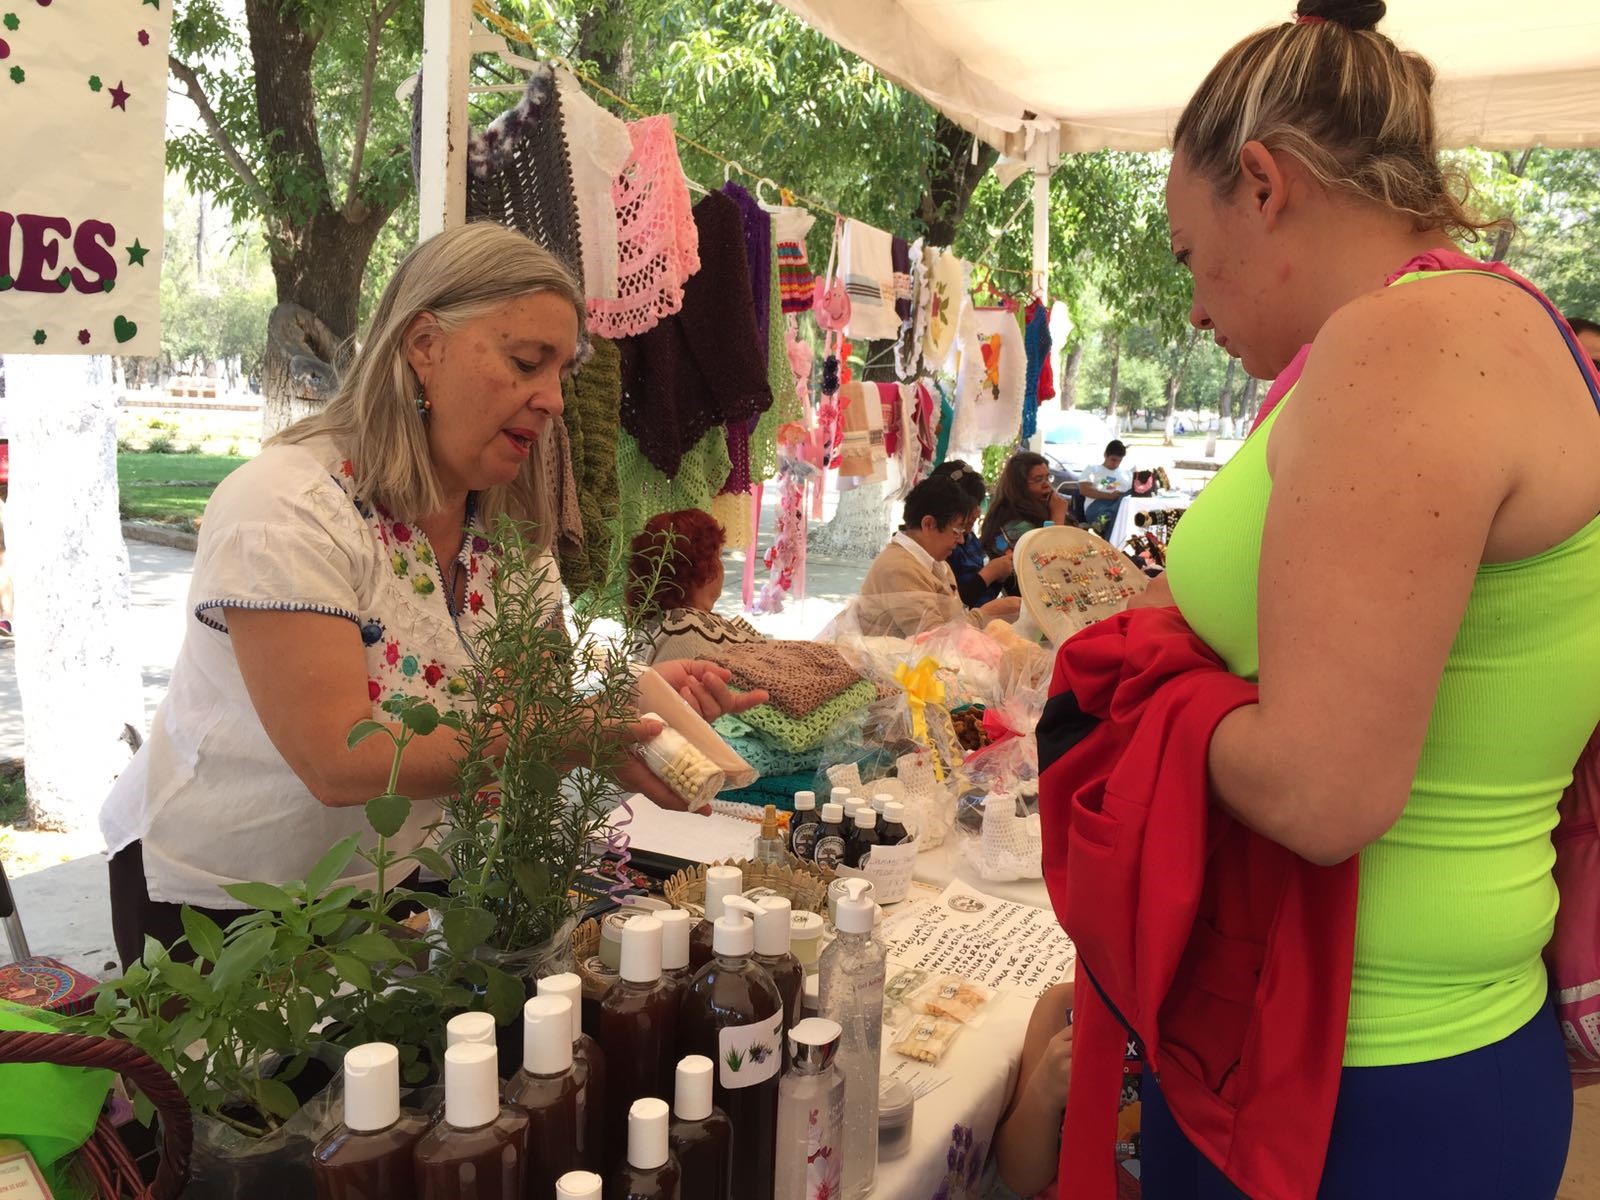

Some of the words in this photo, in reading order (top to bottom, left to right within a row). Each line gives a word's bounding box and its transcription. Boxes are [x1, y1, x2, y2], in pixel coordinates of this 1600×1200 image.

[973, 946, 1007, 982] DOLORES
[1007, 955, 1019, 967] DE
[1011, 953, 1038, 986] JARABE
